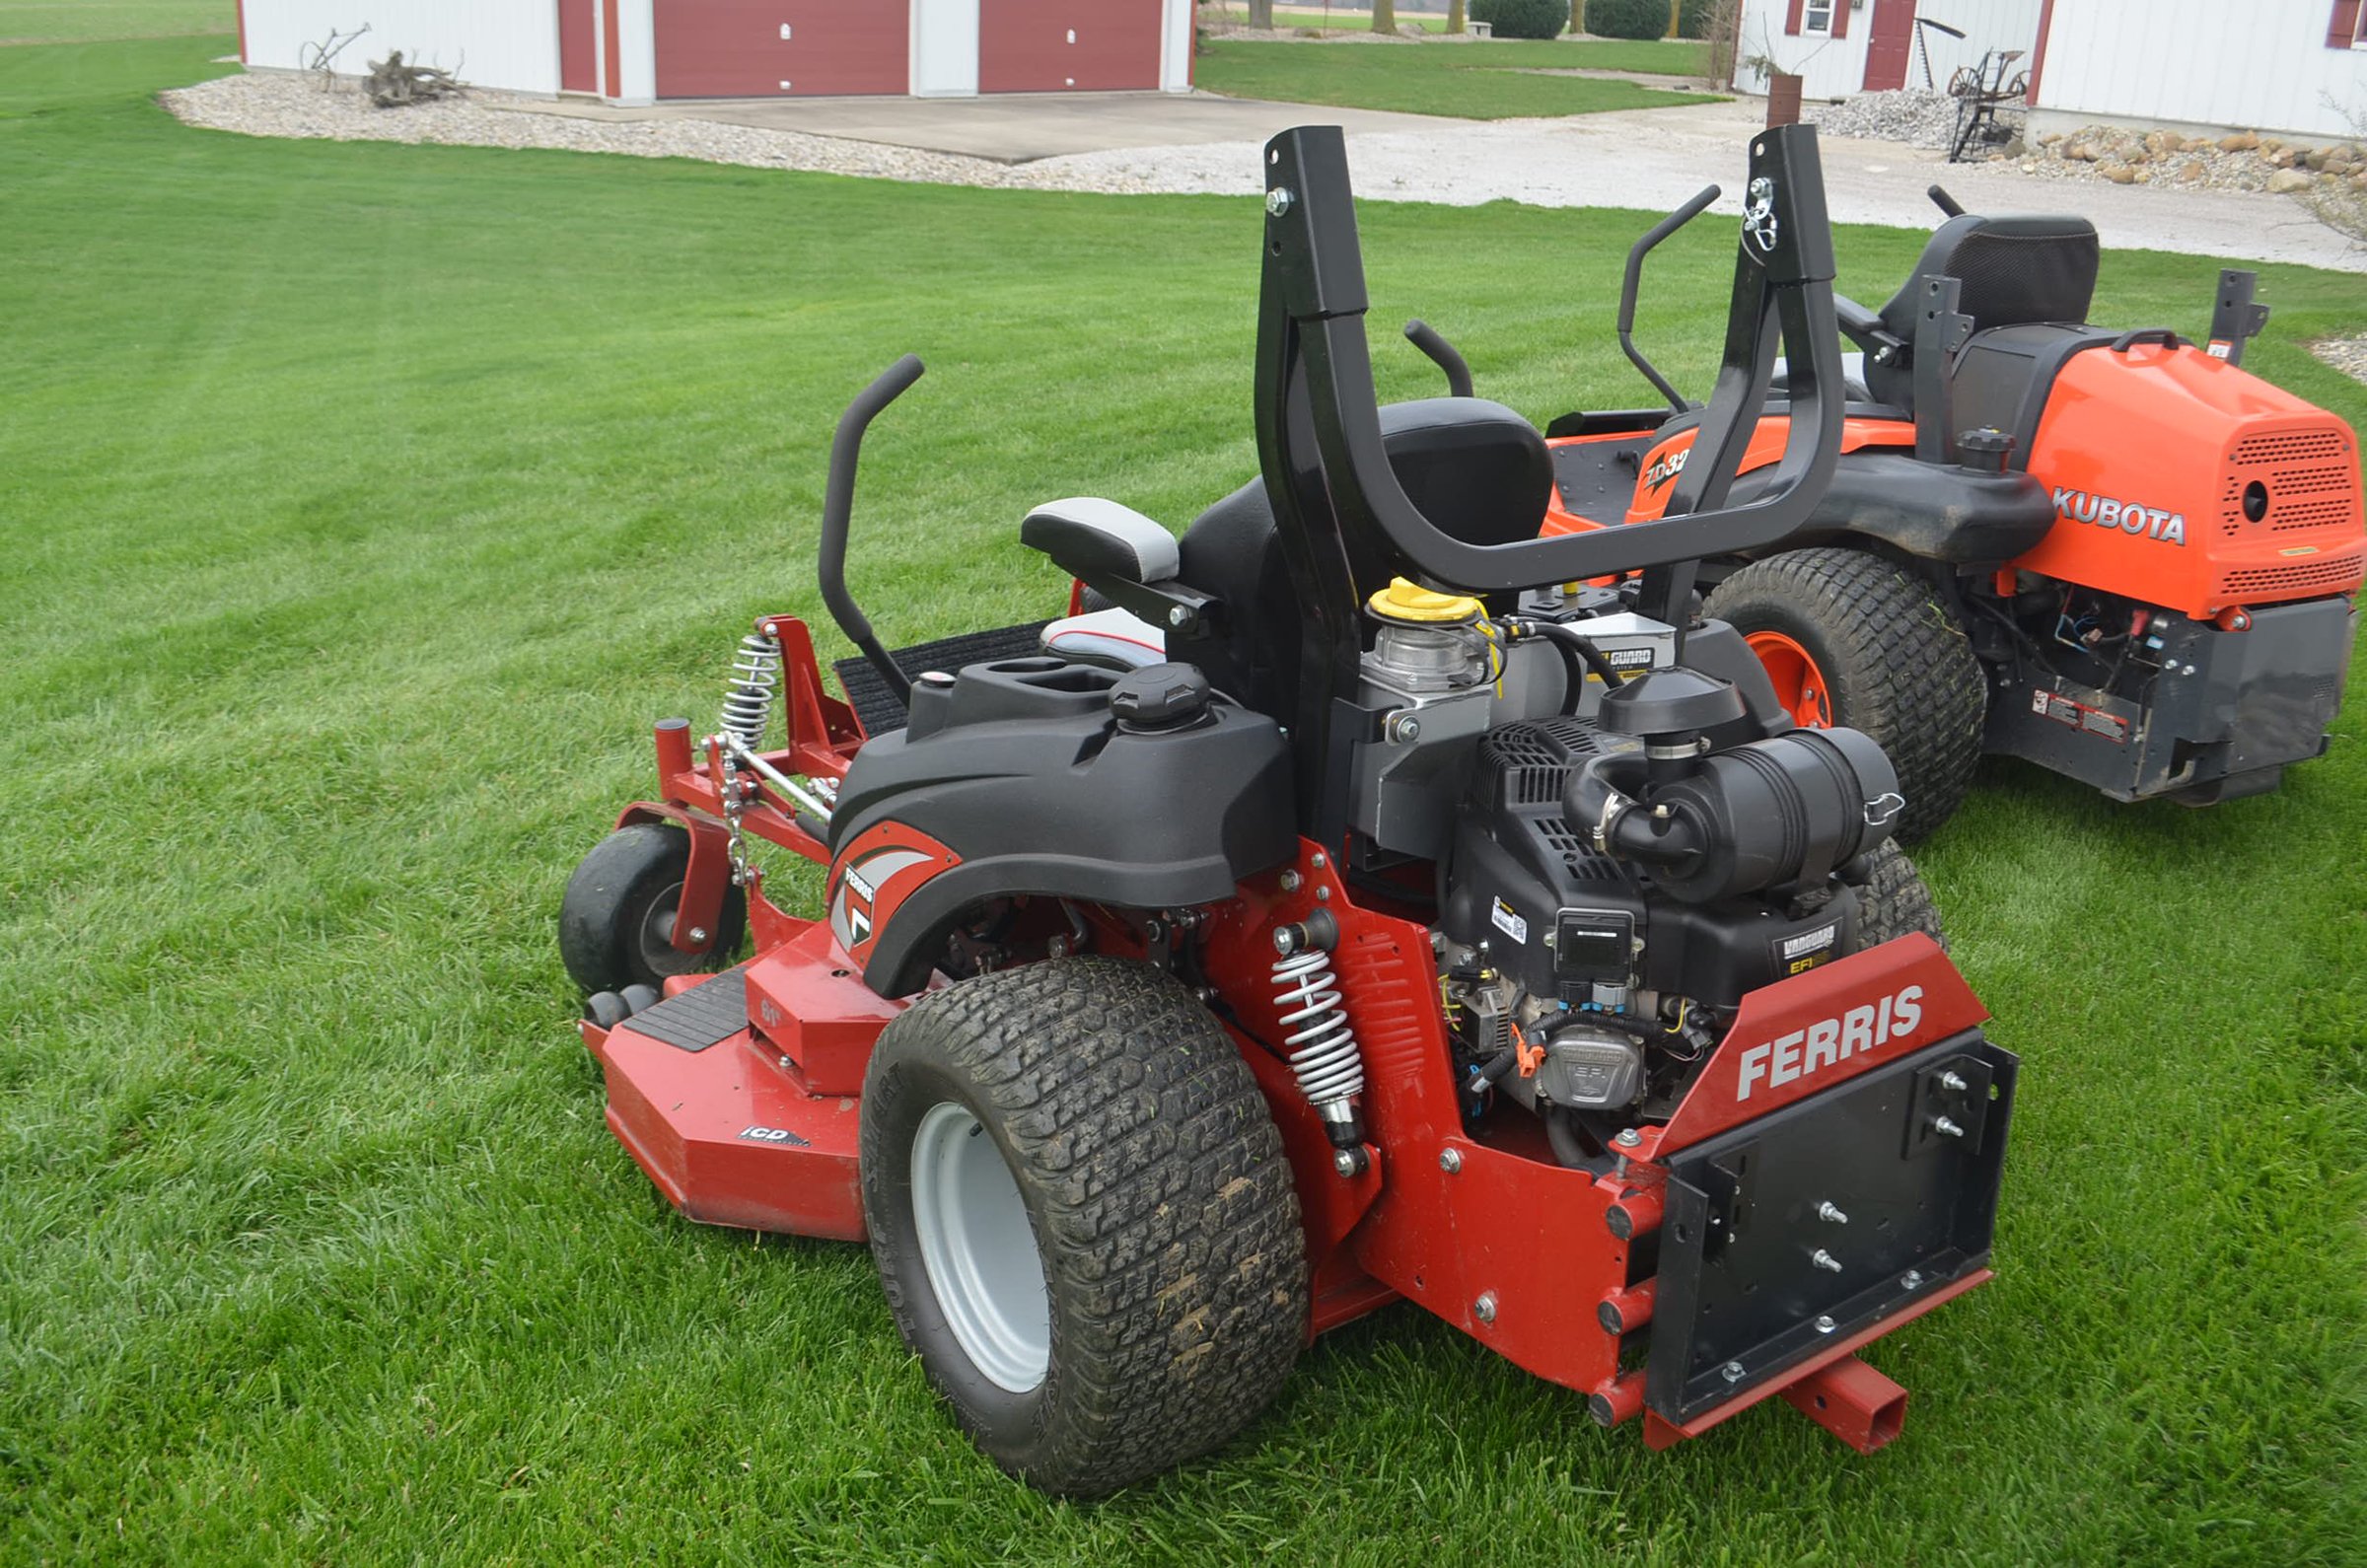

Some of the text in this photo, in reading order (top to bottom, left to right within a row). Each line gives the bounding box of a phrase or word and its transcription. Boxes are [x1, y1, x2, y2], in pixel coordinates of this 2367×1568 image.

[2052, 486, 2186, 546] KUBOTA
[1610, 649, 1652, 666] GUARD
[845, 866, 873, 903] FERRIS
[1790, 957, 1813, 974] EFI
[1737, 985, 1923, 1103] FERRIS
